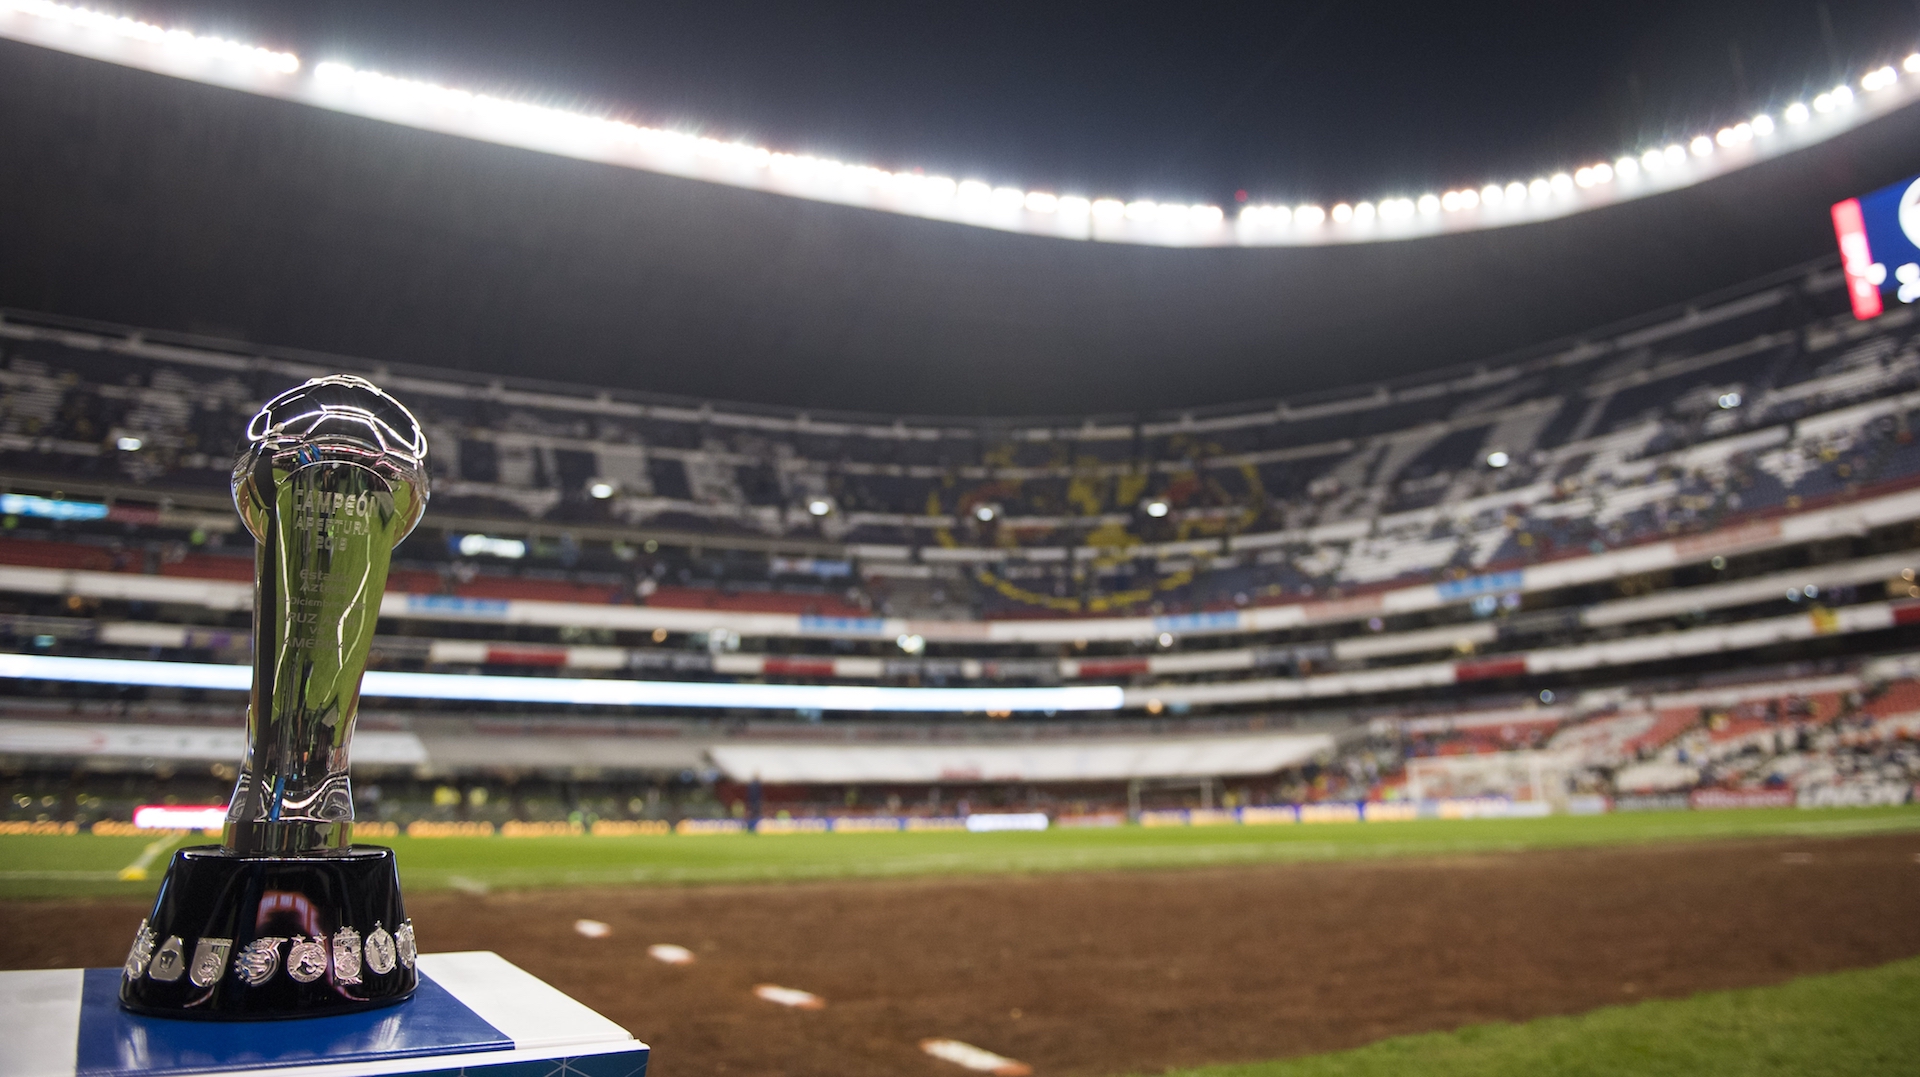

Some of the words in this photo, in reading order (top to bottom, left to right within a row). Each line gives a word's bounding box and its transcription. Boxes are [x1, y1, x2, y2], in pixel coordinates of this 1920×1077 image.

[294, 489, 378, 517] CAMPEÓN
[294, 516, 369, 536] APERTURA
[315, 535, 348, 552] 2018
